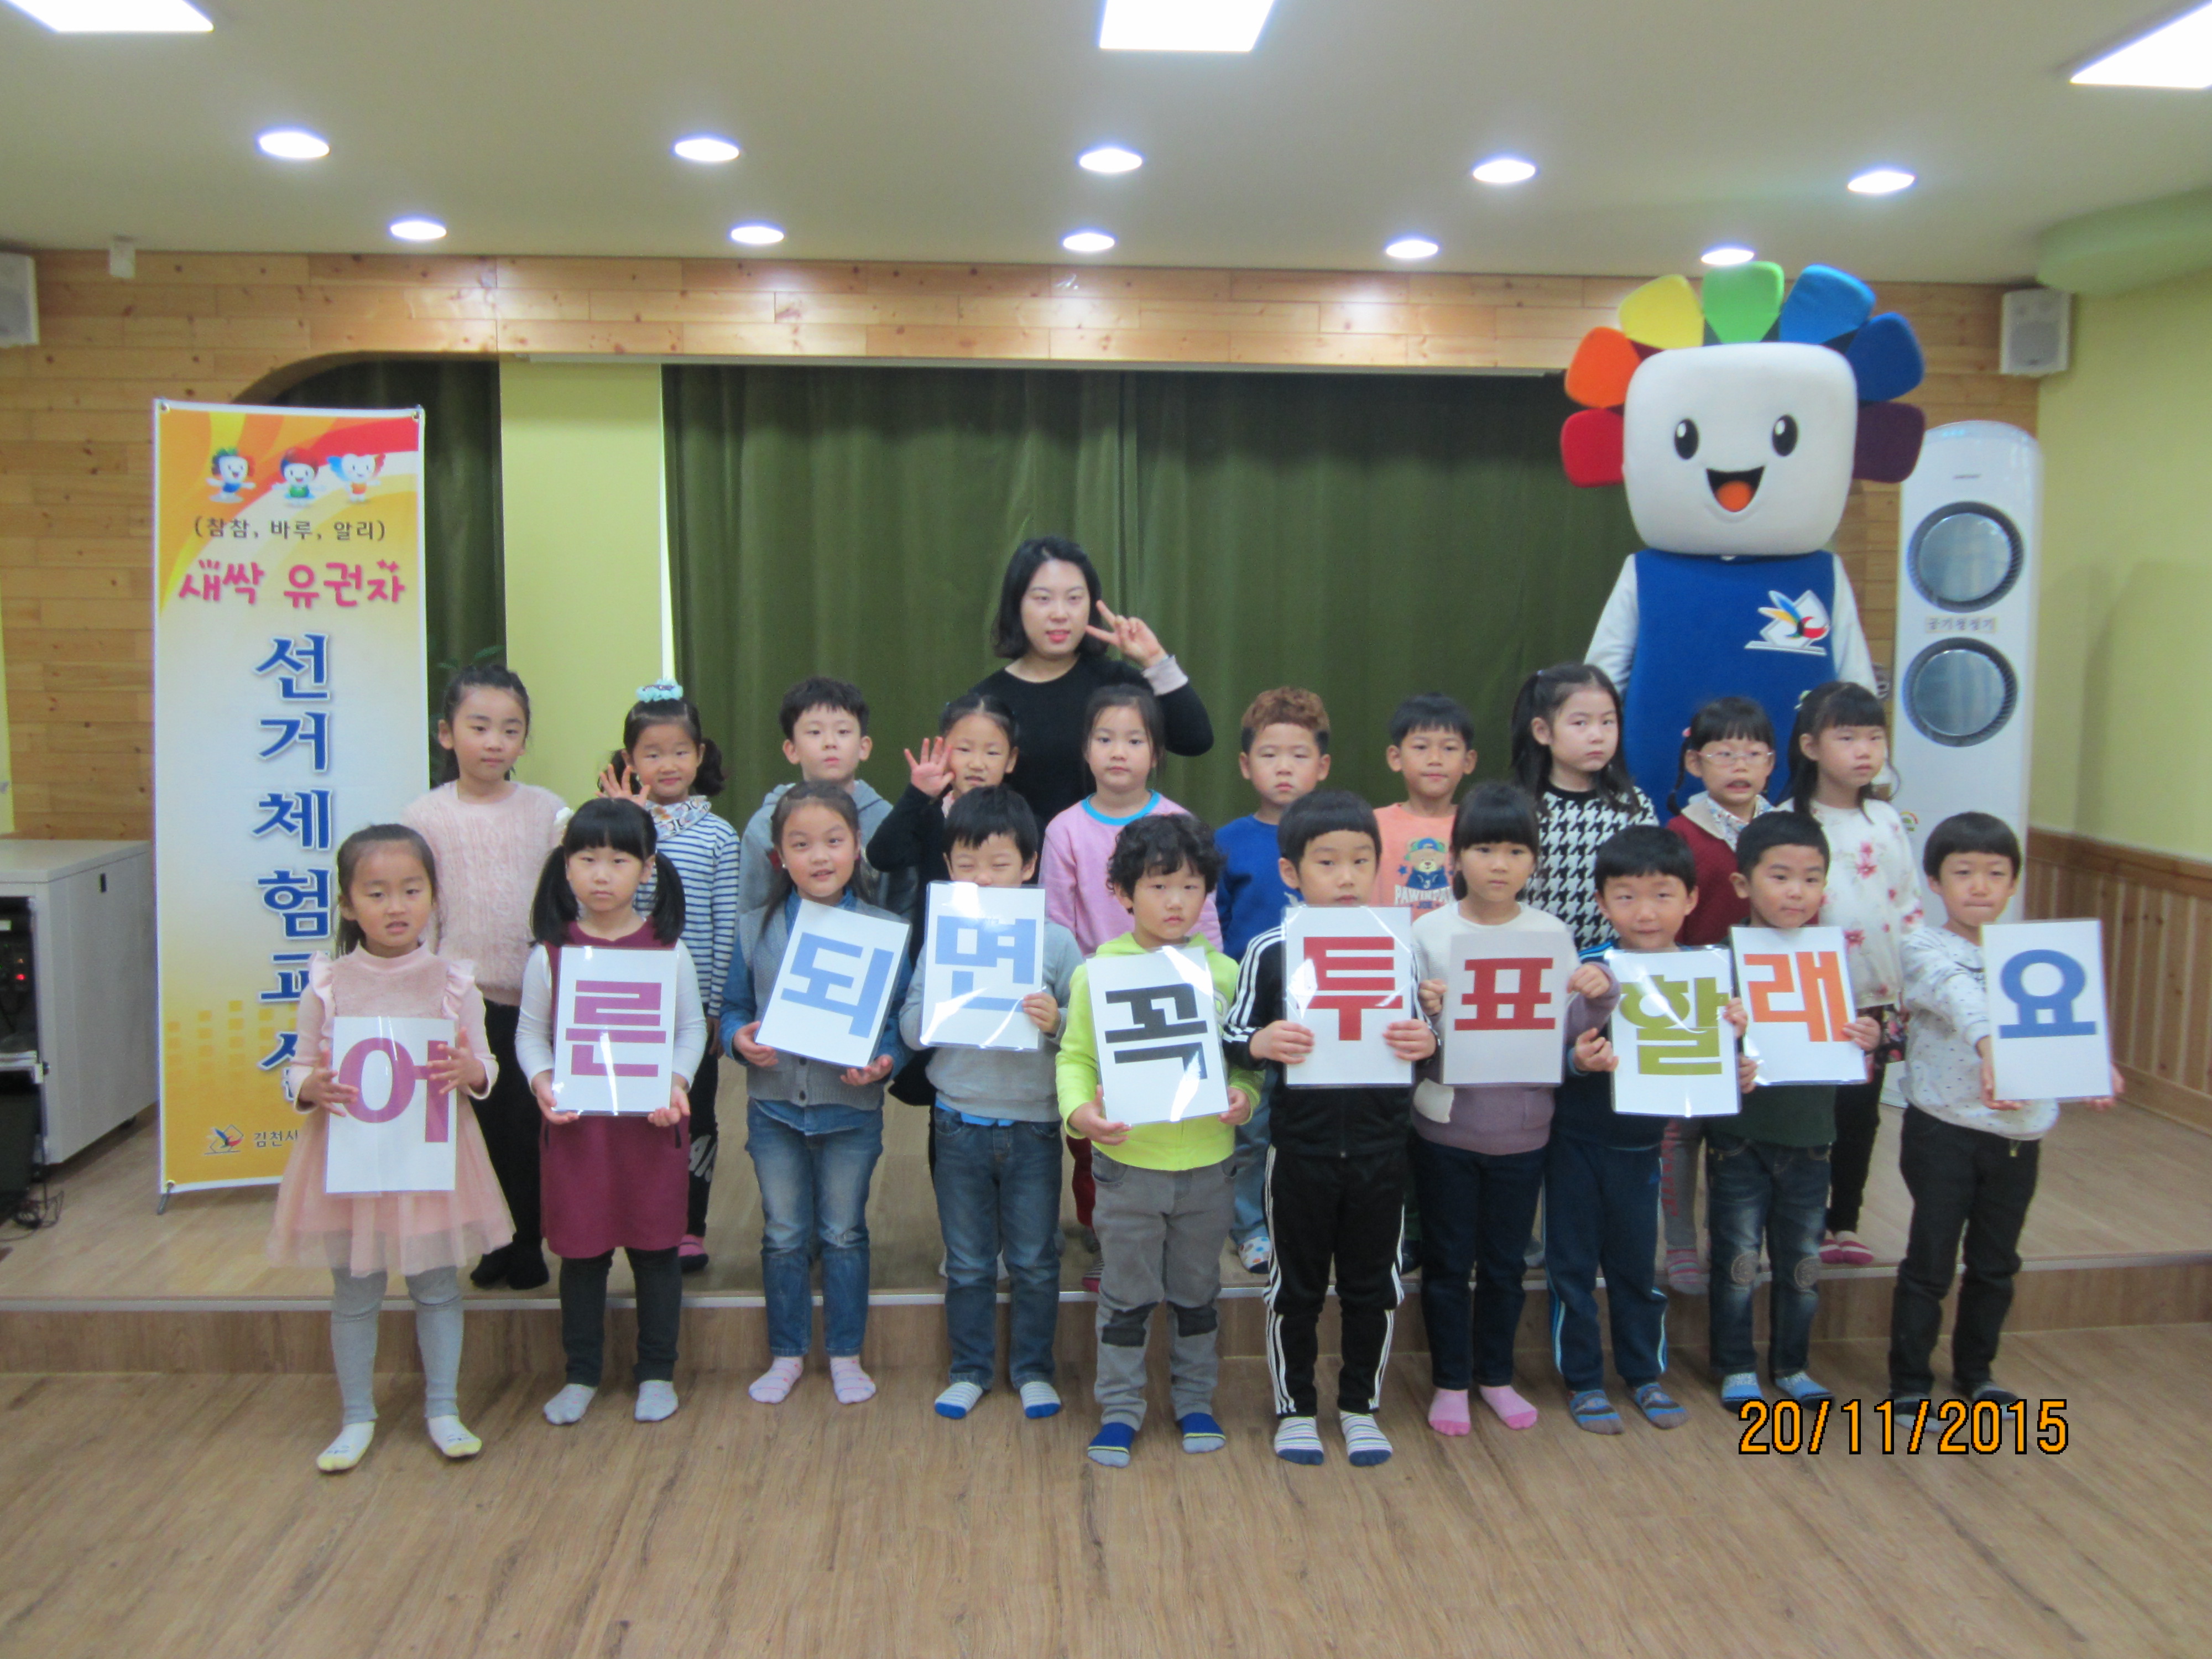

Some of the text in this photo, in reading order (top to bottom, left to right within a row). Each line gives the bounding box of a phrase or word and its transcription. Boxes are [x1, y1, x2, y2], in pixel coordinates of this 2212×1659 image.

[195, 517, 386, 541] (참참, 바루, 알리)
[179, 559, 405, 608] 새싹 유권자
[780, 932, 894, 1039] 되
[935, 915, 1037, 1013] 면
[1296, 936, 1404, 1041] 투
[1454, 957, 1556, 1031] 표
[1744, 951, 1853, 1042] 래
[1998, 949, 2096, 1039] 요
[565, 979, 666, 1077] 른
[1104, 983, 1208, 1080] 꼭
[1619, 974, 1729, 1076] 할
[338, 1037, 448, 1142] 어
